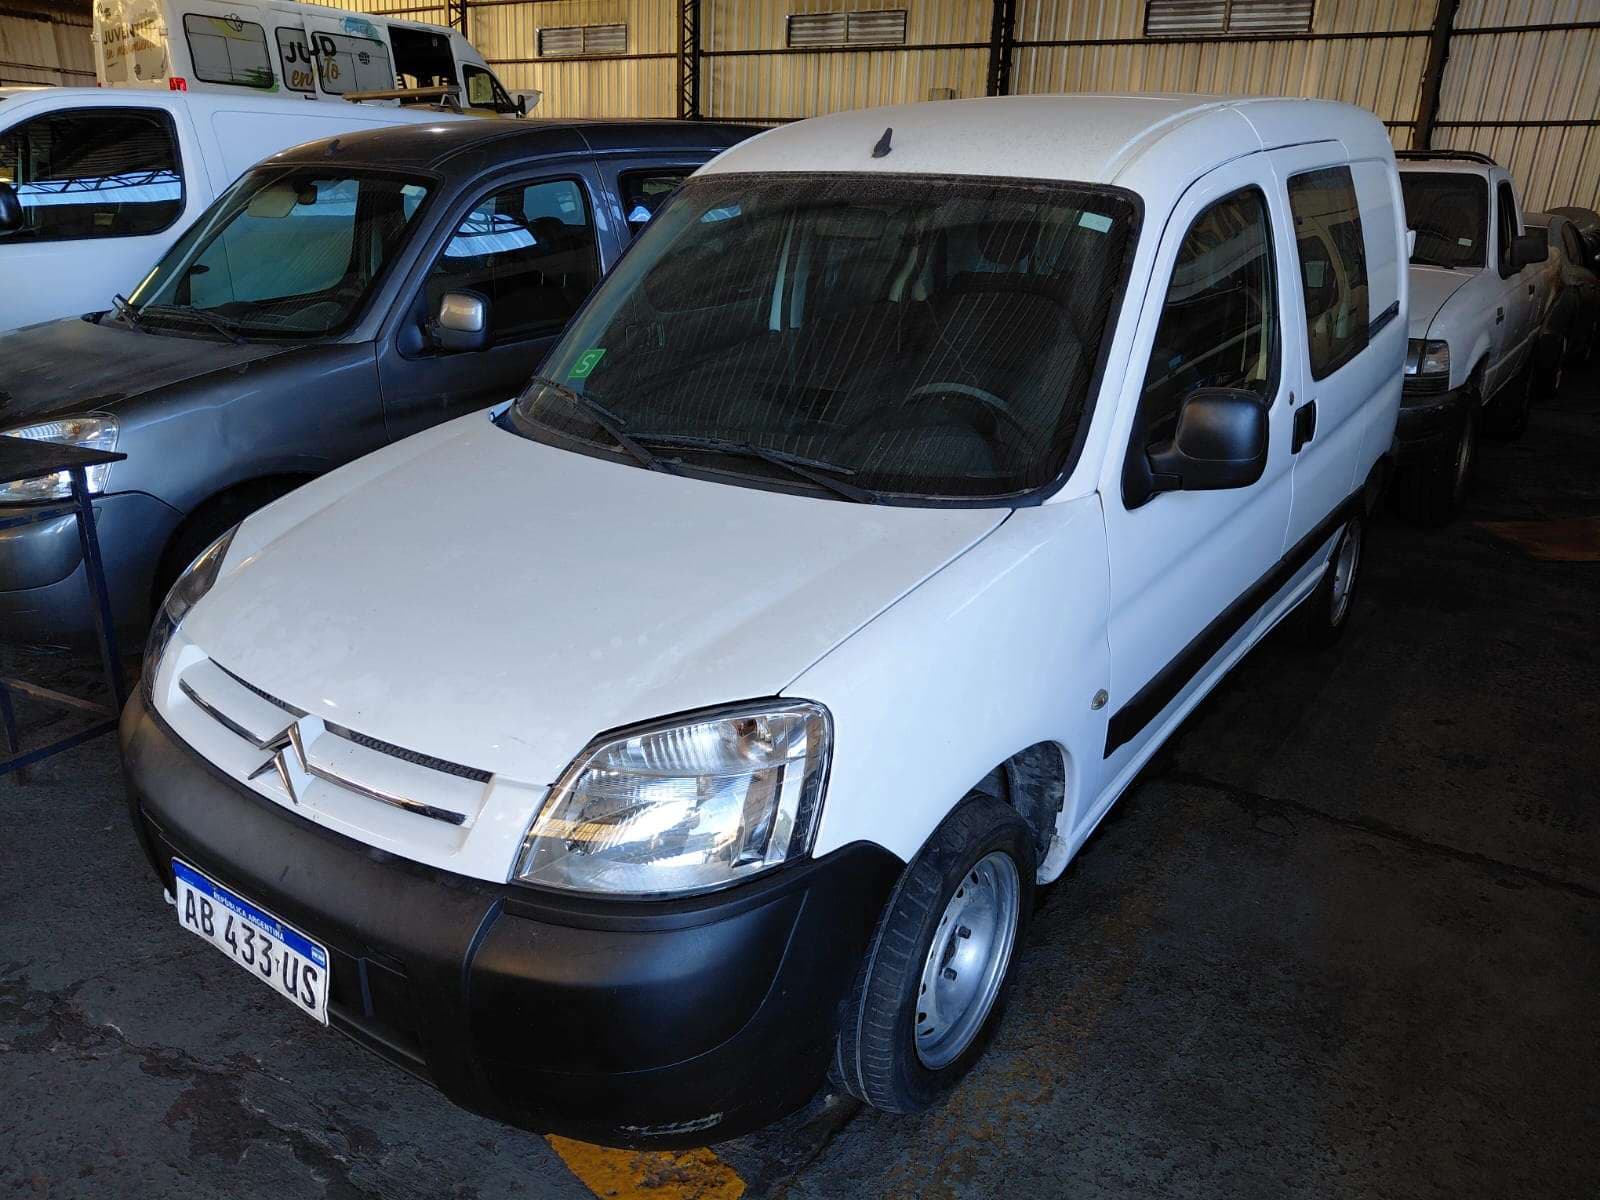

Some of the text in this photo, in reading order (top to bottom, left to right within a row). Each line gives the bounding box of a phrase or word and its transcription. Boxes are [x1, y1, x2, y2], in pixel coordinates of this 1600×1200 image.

[575, 353, 596, 374] S
[248, 913, 285, 941] ARGENTINA
[185, 888, 215, 937] AB
[224, 915, 273, 978] 433
[282, 951, 318, 1010] US
